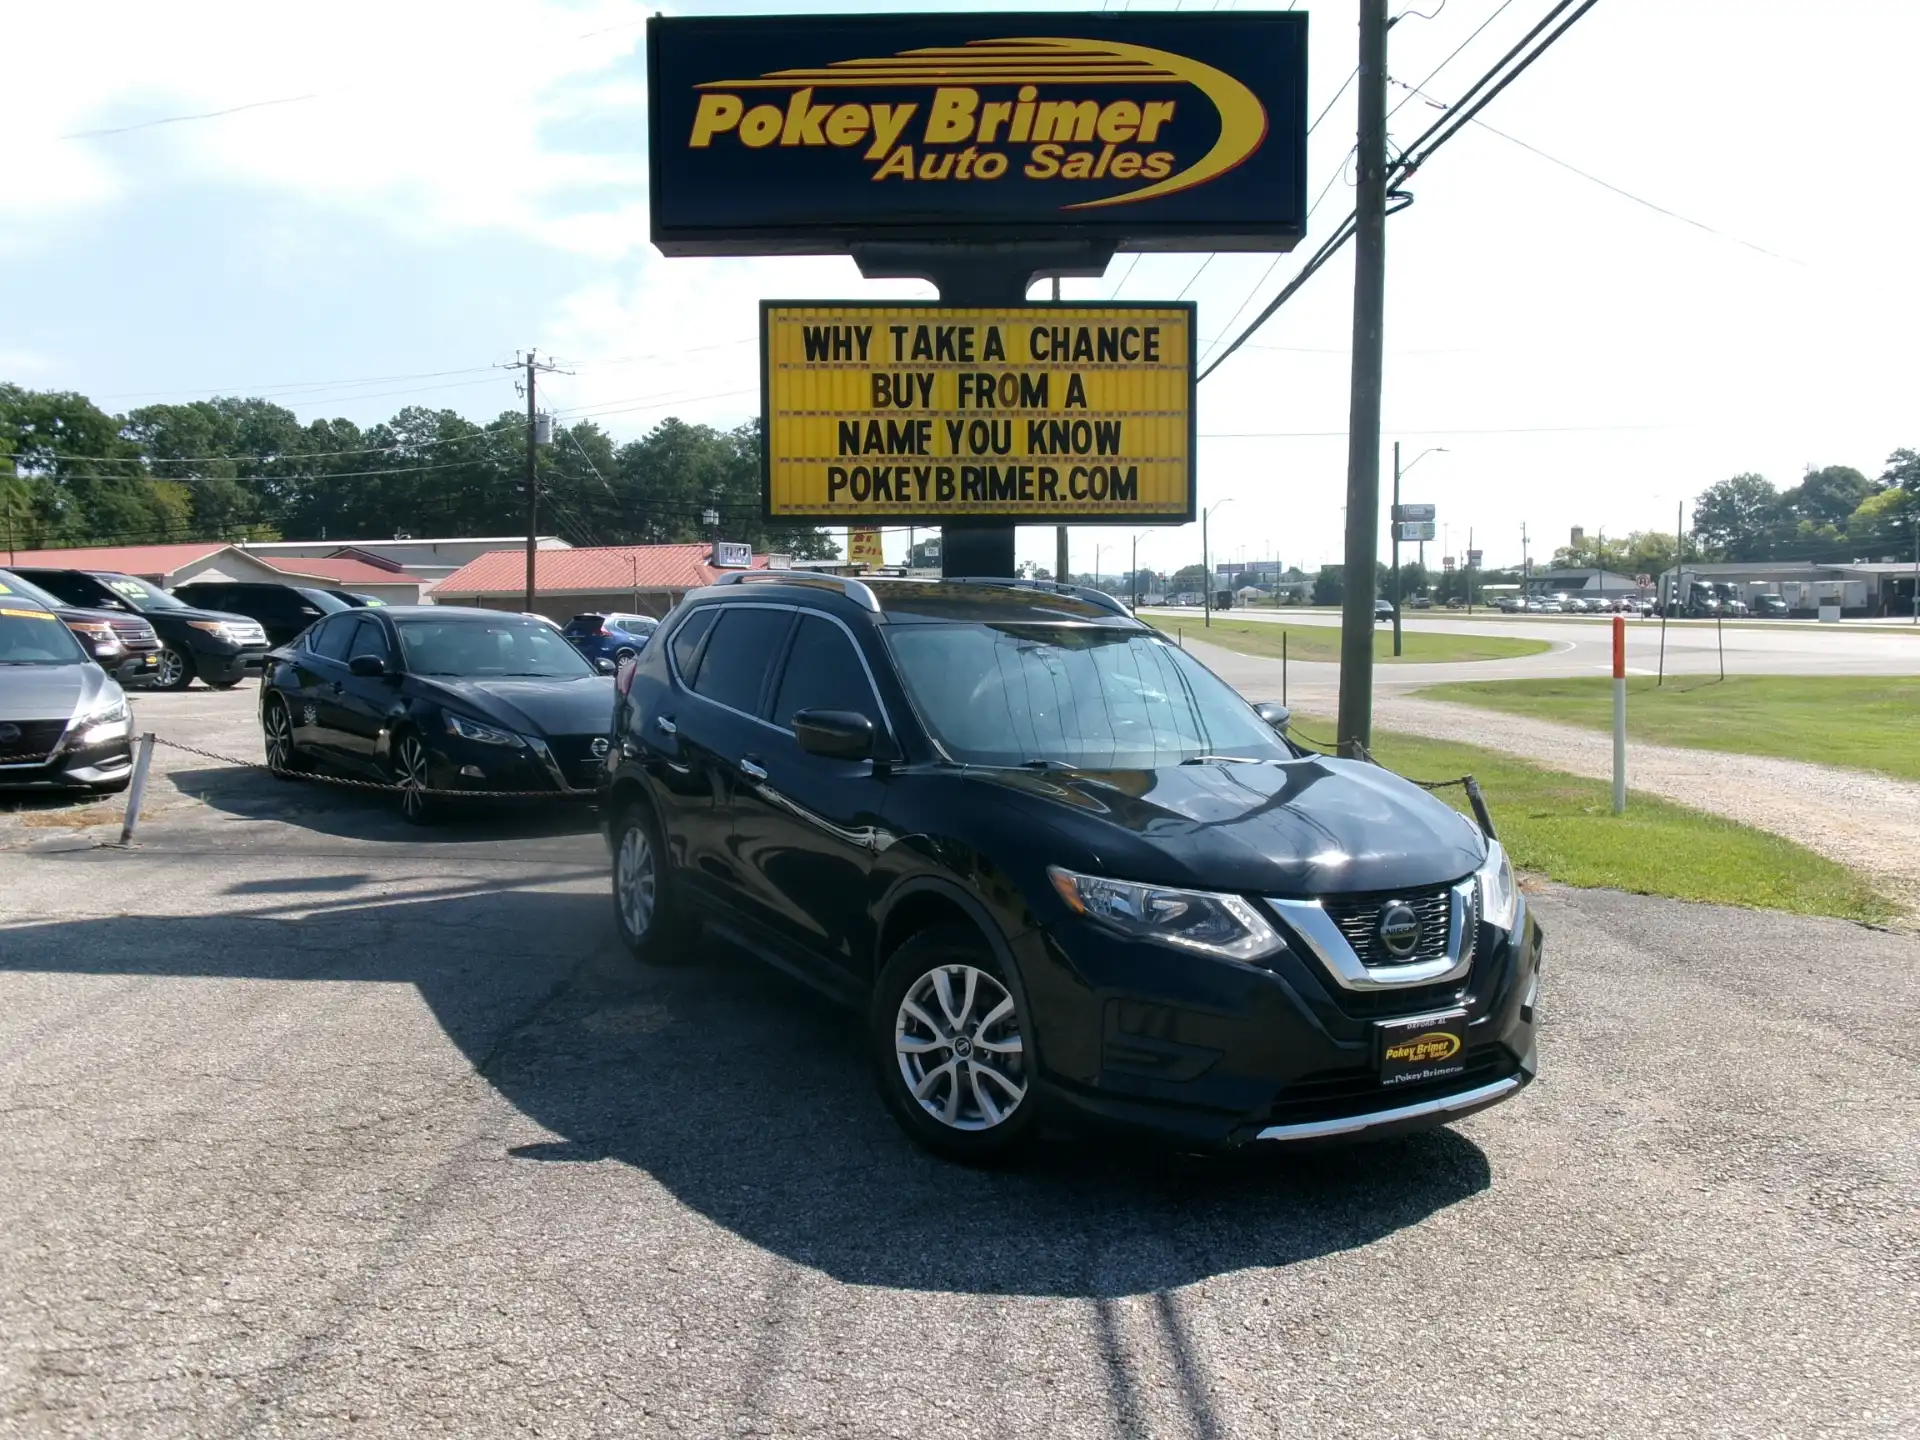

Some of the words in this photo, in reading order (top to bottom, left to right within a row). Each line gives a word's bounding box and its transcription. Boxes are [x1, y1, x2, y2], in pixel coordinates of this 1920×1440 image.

[689, 86, 918, 160] Pokey
[923, 85, 1176, 144] Brimer
[871, 144, 1009, 181] Auto
[1024, 142, 1176, 180] Sales
[803, 325, 873, 362] WHY
[890, 325, 975, 362] TAKE
[983, 325, 1006, 362] A
[1029, 325, 1160, 362] CHANCE
[872, 372, 934, 409] BUY
[958, 372, 1049, 409] FROM
[1064, 372, 1087, 409] A
[838, 419, 932, 456] NAME
[946, 419, 1011, 455] YOU
[1027, 419, 1122, 456] KNOW
[827, 466, 1138, 502] POKEYBRIMER.COM
[1385, 1046, 1416, 1060] Pokey
[1416, 1040, 1449, 1055] Brimer
[1408, 1053, 1426, 1062] Auto
